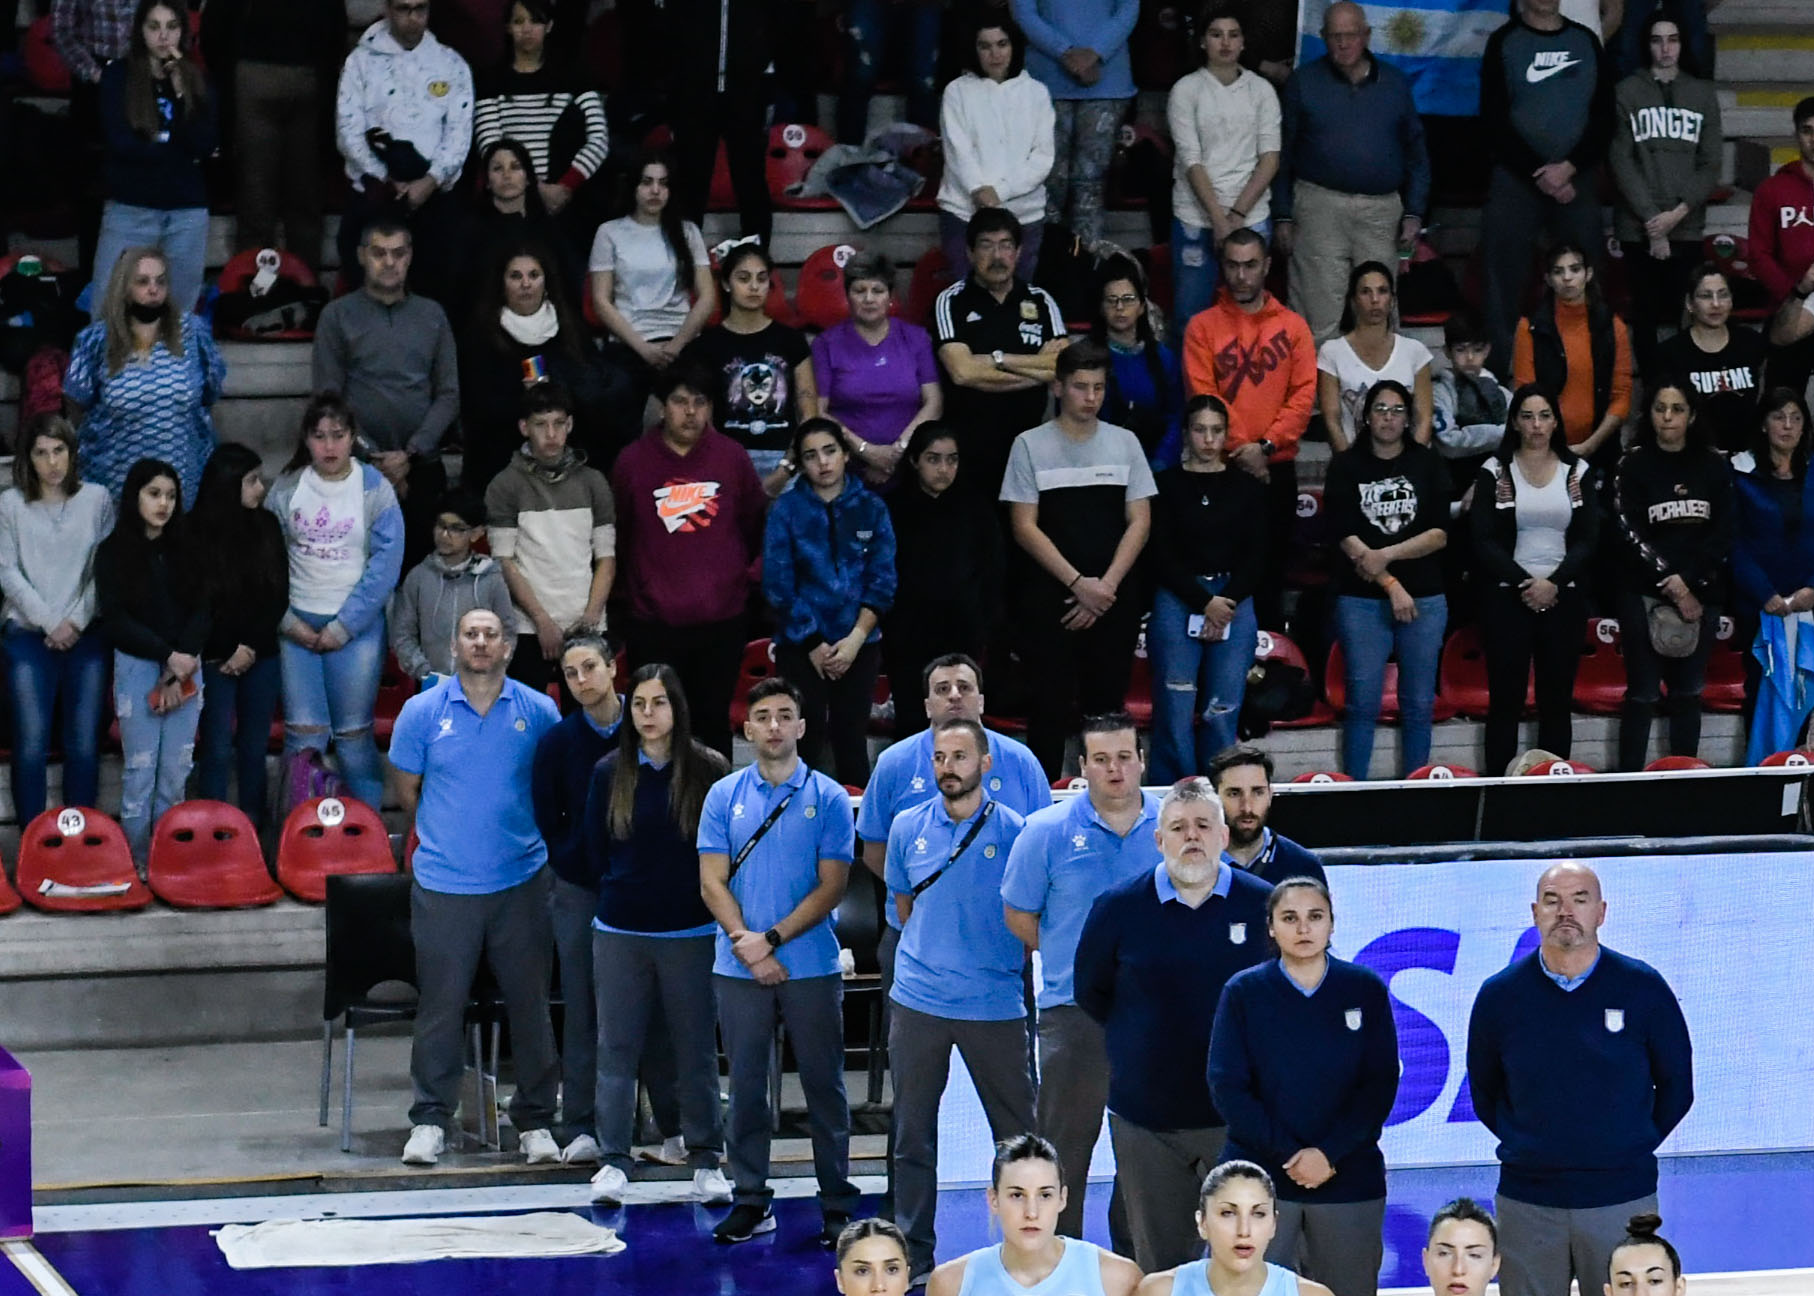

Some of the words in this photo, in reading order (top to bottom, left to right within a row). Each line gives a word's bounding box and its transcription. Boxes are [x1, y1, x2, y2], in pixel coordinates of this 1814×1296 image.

[1535, 51, 1569, 66] NIKE
[322, 806, 340, 817] 45
[62, 815, 80, 827] 43
